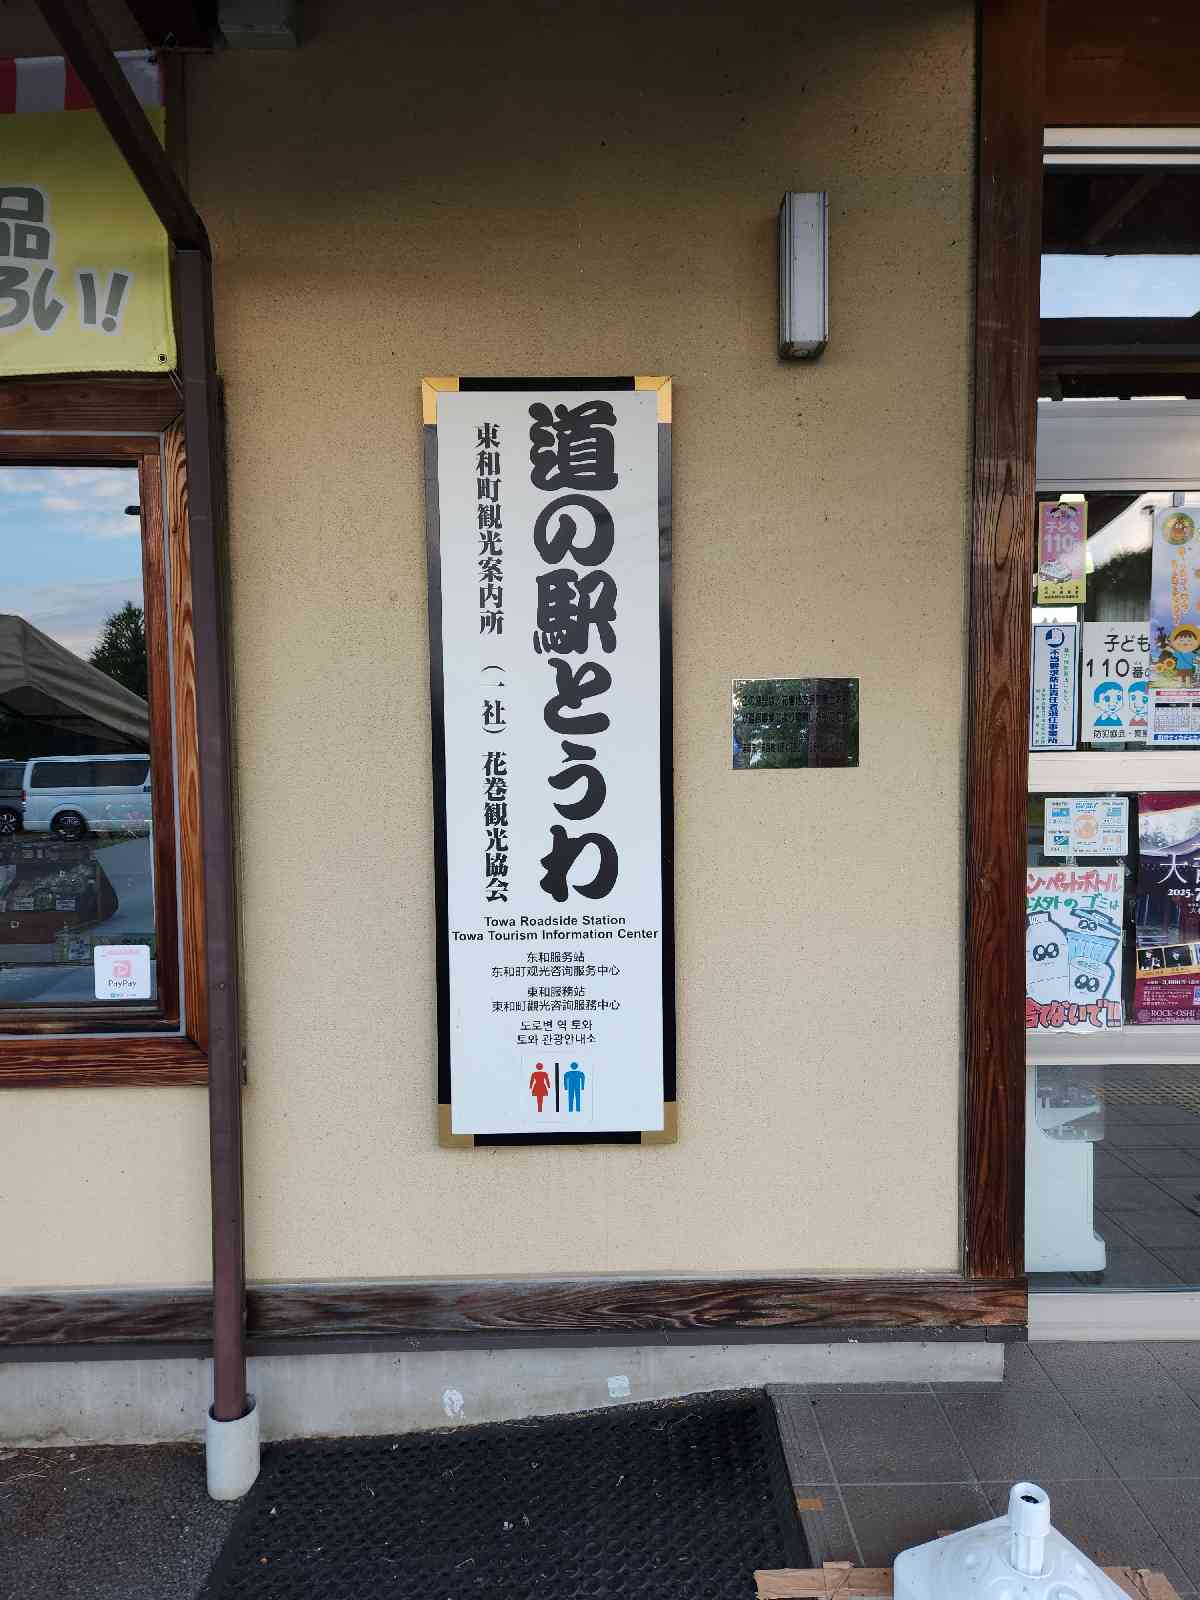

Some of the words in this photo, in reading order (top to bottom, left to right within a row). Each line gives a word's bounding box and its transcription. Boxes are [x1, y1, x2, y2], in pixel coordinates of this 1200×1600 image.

[474, 422, 505, 635] 東和町観光案内所
[529, 400, 618, 902] 道の駅とうわ
[481, 751, 510, 903] 花巻観光協会
[484, 916, 516, 926] Towa
[520, 915, 578, 926] Roadside
[582, 915, 626, 926] Station
[452, 931, 484, 941] Towa
[487, 930, 538, 941] Tourism
[542, 929, 613, 940] Information
[617, 929, 659, 939] Center
[527, 951, 585, 963] 东和服务站
[108, 979, 137, 988] PayPay
[527, 985, 586, 998] 東和服務站
[571, 1020, 593, 1031] 토와
[517, 1034, 538, 1046] 토와
[542, 1033, 597, 1045] 관광안내소
